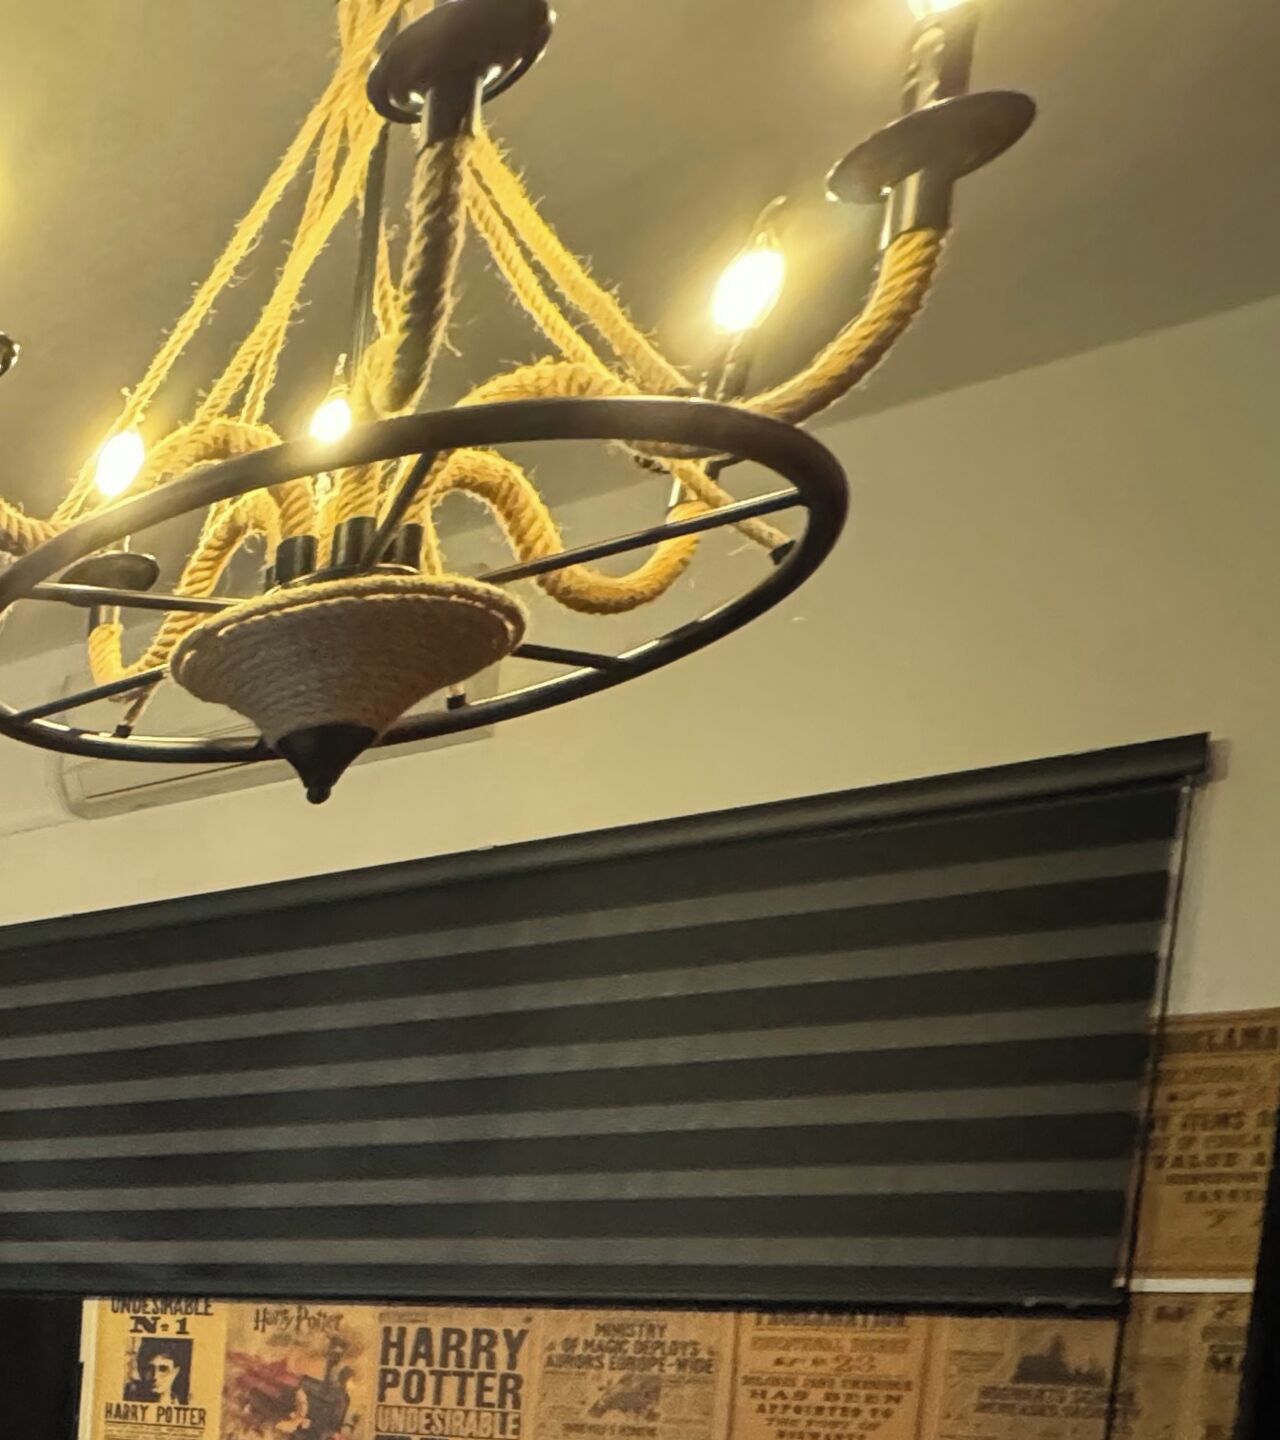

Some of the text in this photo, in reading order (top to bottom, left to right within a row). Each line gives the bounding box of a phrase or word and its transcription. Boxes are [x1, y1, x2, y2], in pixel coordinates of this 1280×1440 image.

[253, 1305, 344, 1334] Harry Potter
[380, 1326, 529, 1370] HARRY
[377, 1368, 524, 1410] POTTER
[104, 1402, 207, 1426] HARRY POTTER
[377, 1408, 520, 1439] UNDESIRABLE
